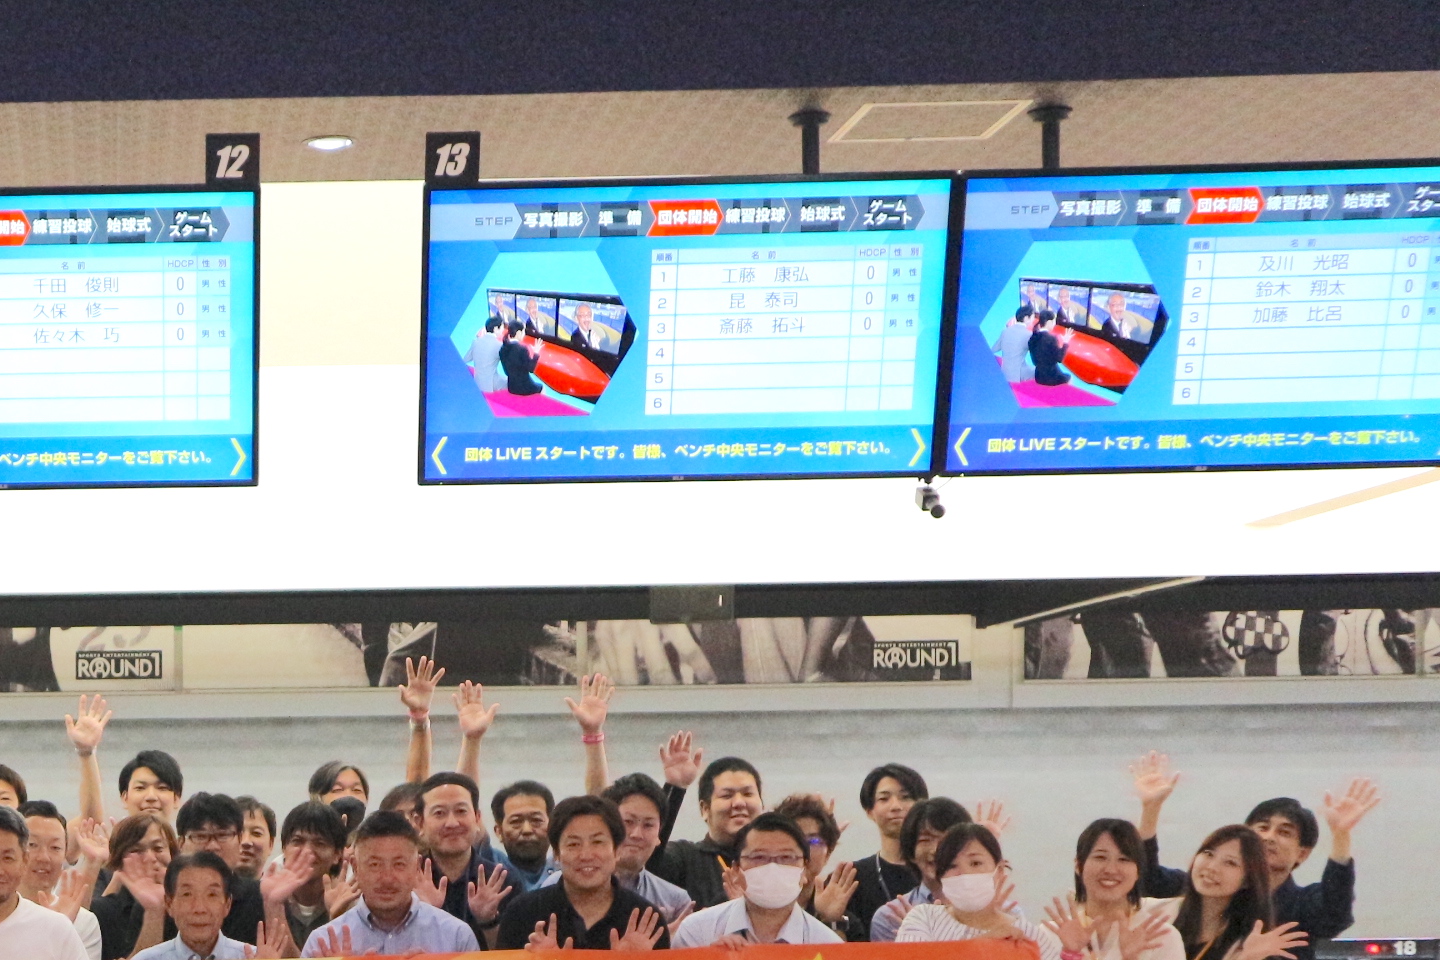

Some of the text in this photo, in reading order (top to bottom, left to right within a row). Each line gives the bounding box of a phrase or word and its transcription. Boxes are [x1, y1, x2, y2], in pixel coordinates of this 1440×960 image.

[216, 144, 249, 178] 12
[435, 143, 471, 176] 13
[870, 198, 908, 213] ゲーム
[1010, 205, 1049, 214] STEP
[1059, 199, 1122, 216] 写真撮影
[1196, 196, 1260, 213] 団体開始
[1265, 193, 1330, 211] 練習投球
[1342, 191, 1391, 209] 始球式
[175, 210, 212, 225] ゲーム
[475, 216, 513, 226] STEP
[523, 211, 584, 227] 写真撮影
[657, 208, 718, 225] 団体開始
[724, 206, 786, 224] 練習投球
[799, 205, 846, 222] 始球式
[862, 210, 913, 226] スタート
[33, 218, 92, 234] 練習投球
[107, 217, 151, 233] 始球式
[168, 222, 218, 237] スタート
[858, 248, 886, 256] HDCP
[167, 259, 194, 267] HDCP
[1196, 253, 1417, 271] 1 及川 光昭 0
[660, 265, 875, 283] 1 工藤 康弘 0
[33, 277, 66, 293] 千田
[84, 276, 118, 293] 俊則
[177, 277, 184, 291] 0
[1191, 286, 1202, 297] 2
[1254, 280, 1292, 298] 鈴木
[1404, 278, 1414, 293] 0
[657, 297, 667, 309] 2
[764, 291, 798, 308] 泰司
[865, 291, 874, 305] 0
[33, 303, 67, 319] 久保
[85, 302, 118, 318] 修一
[177, 302, 184, 315] 0
[1188, 305, 1410, 324] 3 加藤 比呂 0
[655, 322, 665, 334] 3
[771, 317, 805, 334] 拓斗
[863, 317, 872, 330] 0
[33, 328, 84, 344] 佐々木
[103, 327, 119, 344] 巧
[177, 328, 184, 340] 0
[1186, 336, 1196, 347] 4
[655, 347, 665, 358] 4
[1184, 362, 1194, 373] 5
[654, 372, 664, 383] 5
[1180, 387, 1191, 398] 6
[652, 397, 662, 408] 6
[1394, 940, 1417, 955] 18
